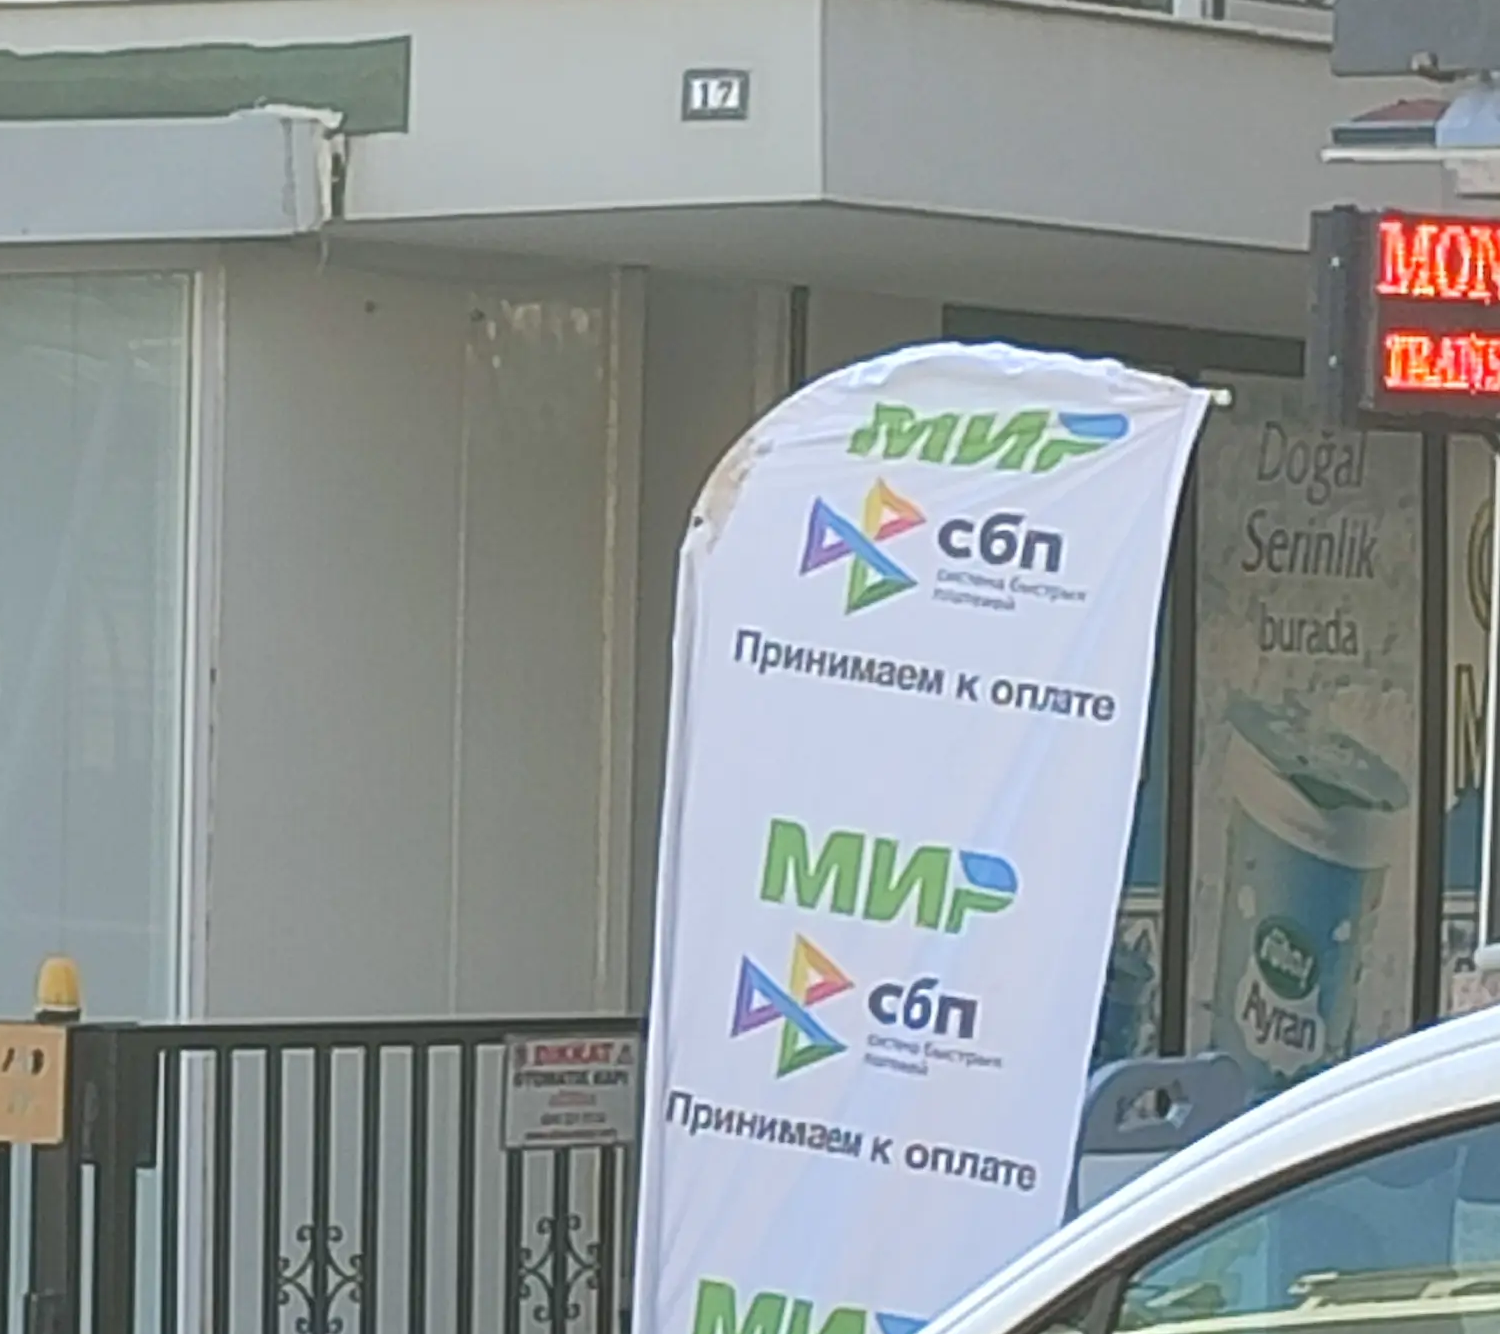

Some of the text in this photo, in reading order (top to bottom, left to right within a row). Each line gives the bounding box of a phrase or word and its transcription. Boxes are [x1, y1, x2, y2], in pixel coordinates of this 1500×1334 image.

[700, 78, 734, 108] 17
[846, 402, 1128, 474] МИР
[1257, 420, 1368, 506] Doğal
[1241, 508, 1378, 579] Serinlik
[1259, 600, 1359, 657] burada
[733, 629, 1117, 722] Принимаем к оплате
[759, 817, 1019, 935] МИР
[1242, 979, 1318, 1053] Ayran
[665, 1090, 1038, 1191] Принимаем к оплате
